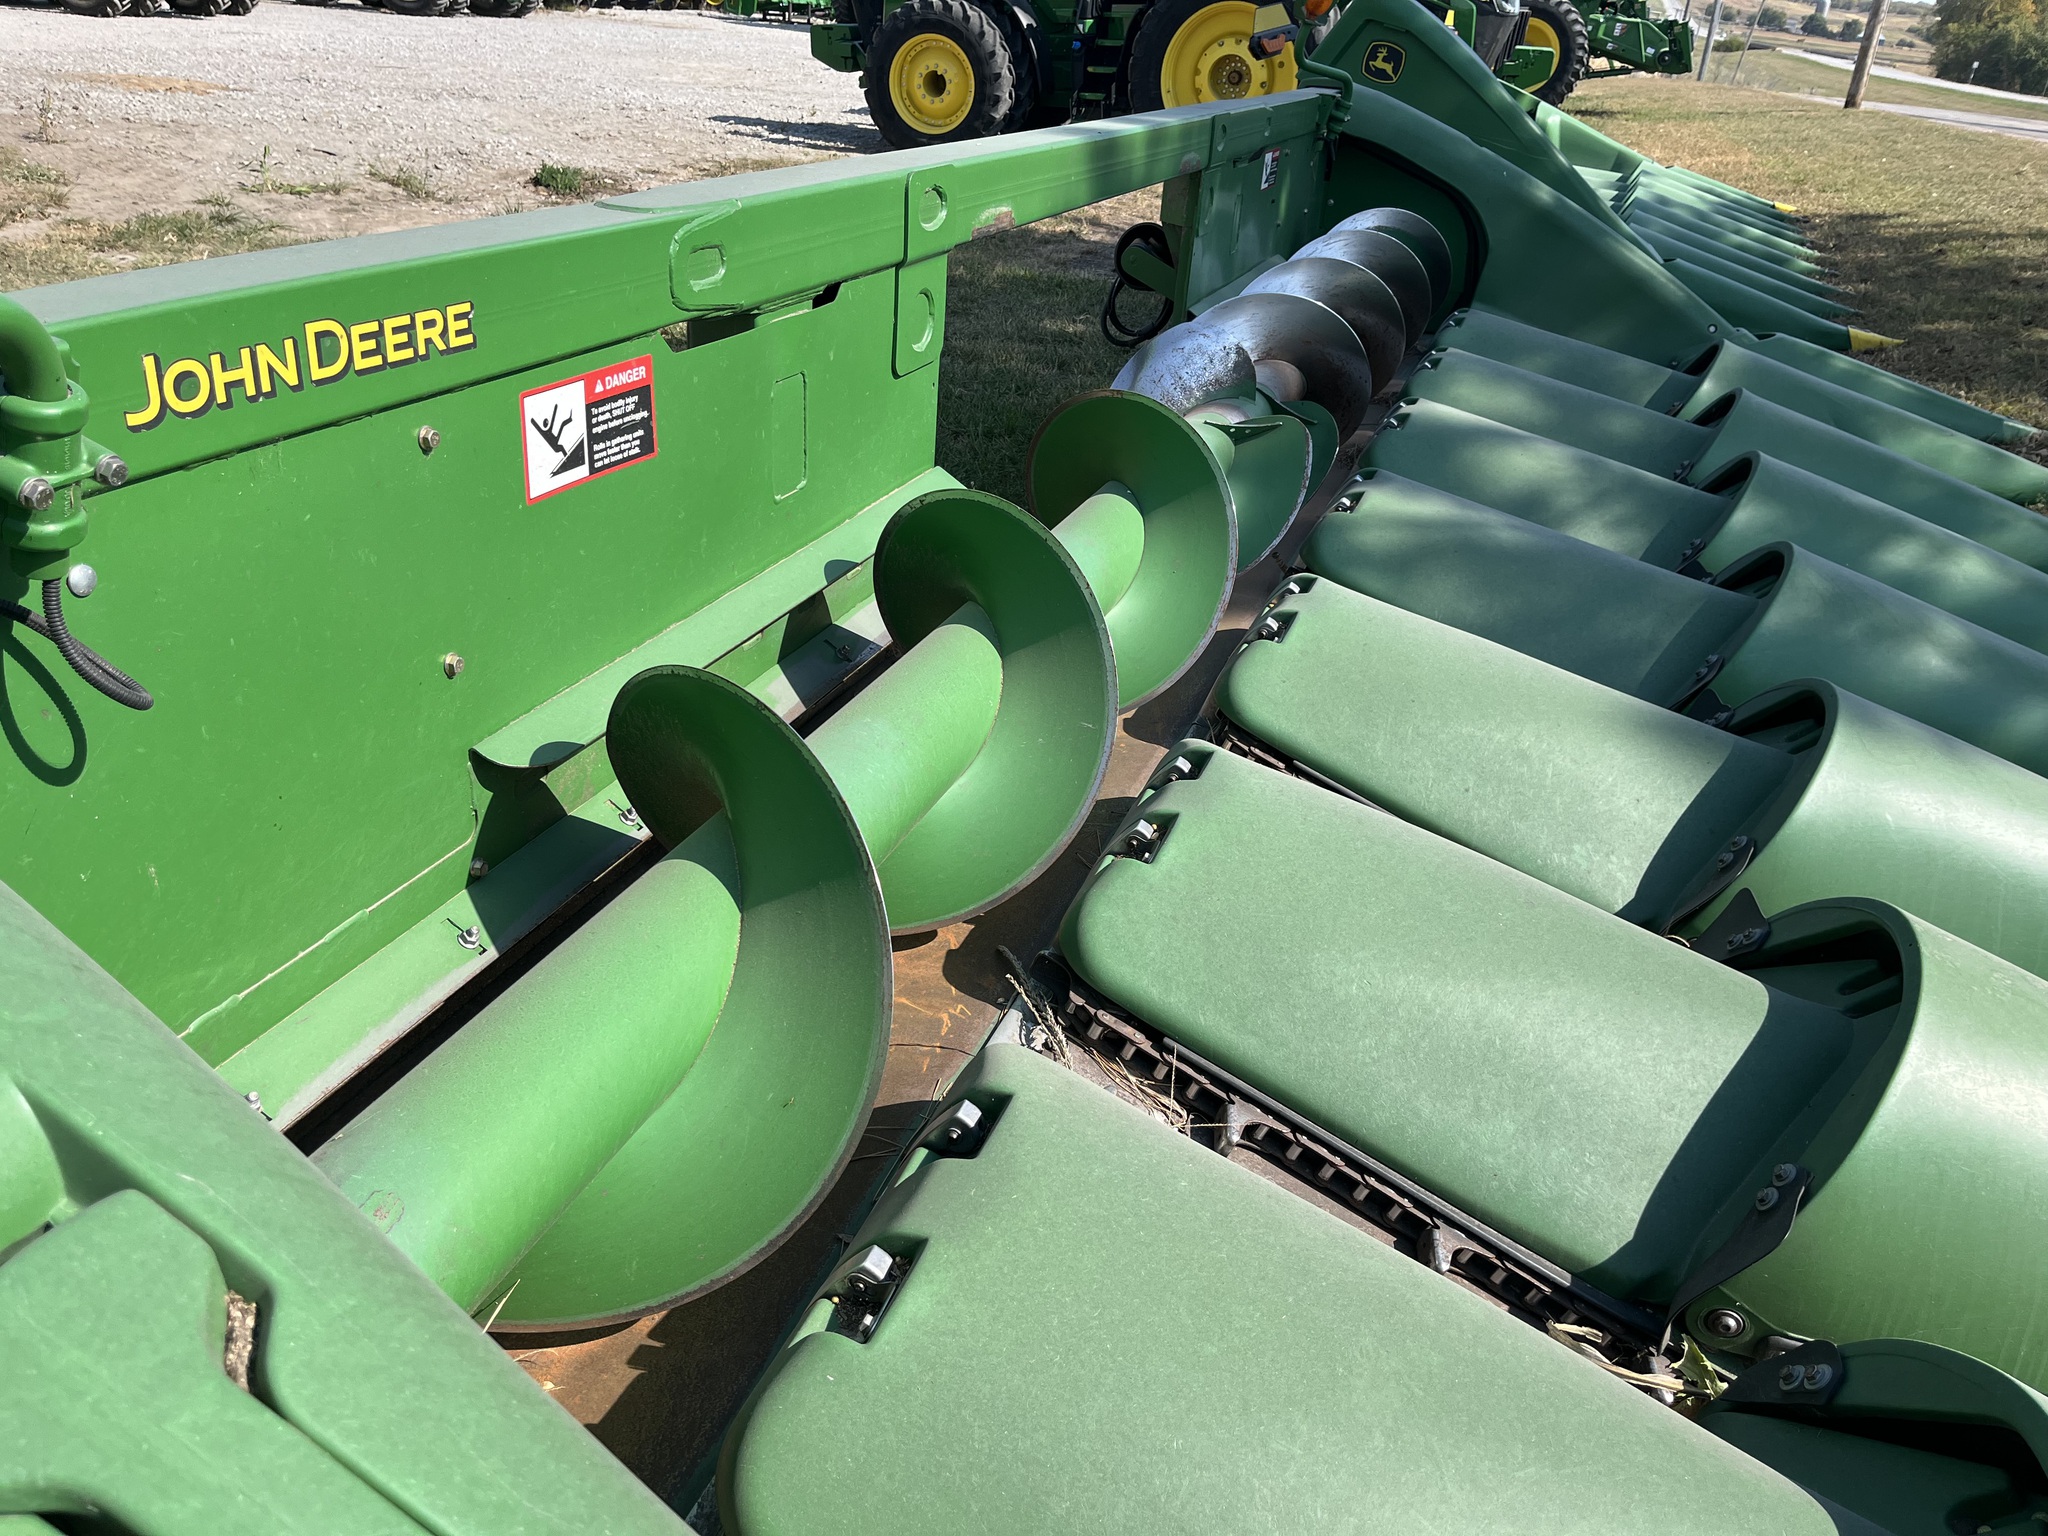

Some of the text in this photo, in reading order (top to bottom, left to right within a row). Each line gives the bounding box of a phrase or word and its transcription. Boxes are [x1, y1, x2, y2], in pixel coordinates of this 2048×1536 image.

[124, 301, 477, 433] JOHN DEERE
[605, 366, 646, 390] DANGER
[598, 403, 611, 413] avoid
[611, 399, 625, 409] bodily
[612, 406, 625, 417] SHUT
[625, 403, 636, 413] OFF
[592, 424, 608, 434] engine
[608, 418, 623, 428] before
